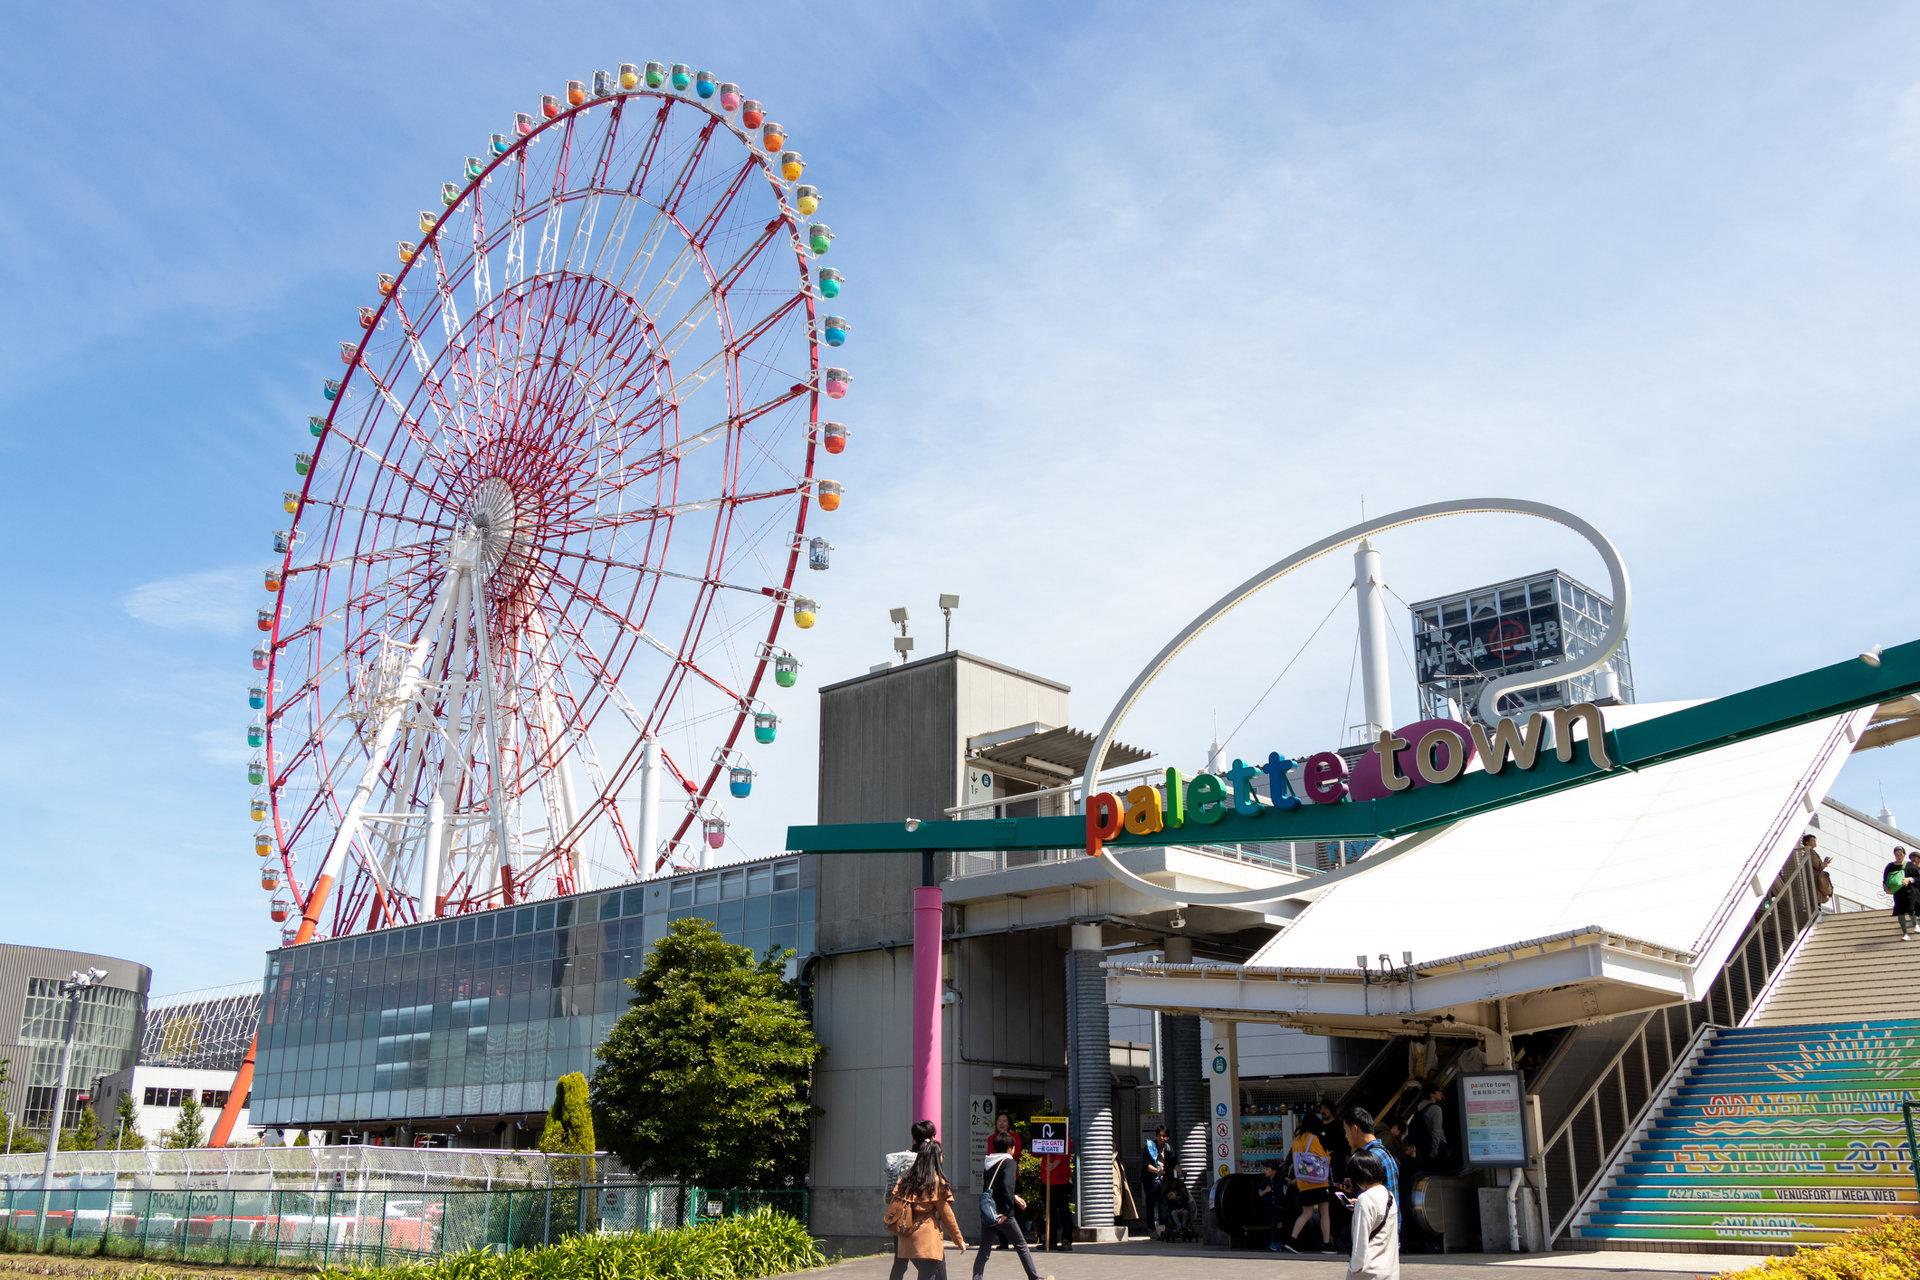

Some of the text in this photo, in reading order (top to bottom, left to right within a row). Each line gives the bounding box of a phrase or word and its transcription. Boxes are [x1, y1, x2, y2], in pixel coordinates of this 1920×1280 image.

[1417, 638, 1487, 668] MEGA
[970, 785, 979, 795] 1F
[1086, 703, 1614, 856] palette town
[1702, 1093, 1820, 1116] ODAIBA
[1664, 1143, 1826, 1173] FESTIVAL
[1776, 1189, 1832, 1200] VENUSFORT
[1842, 1190, 1870, 1201] MEGA
[1871, 1191, 1897, 1201] WEB
